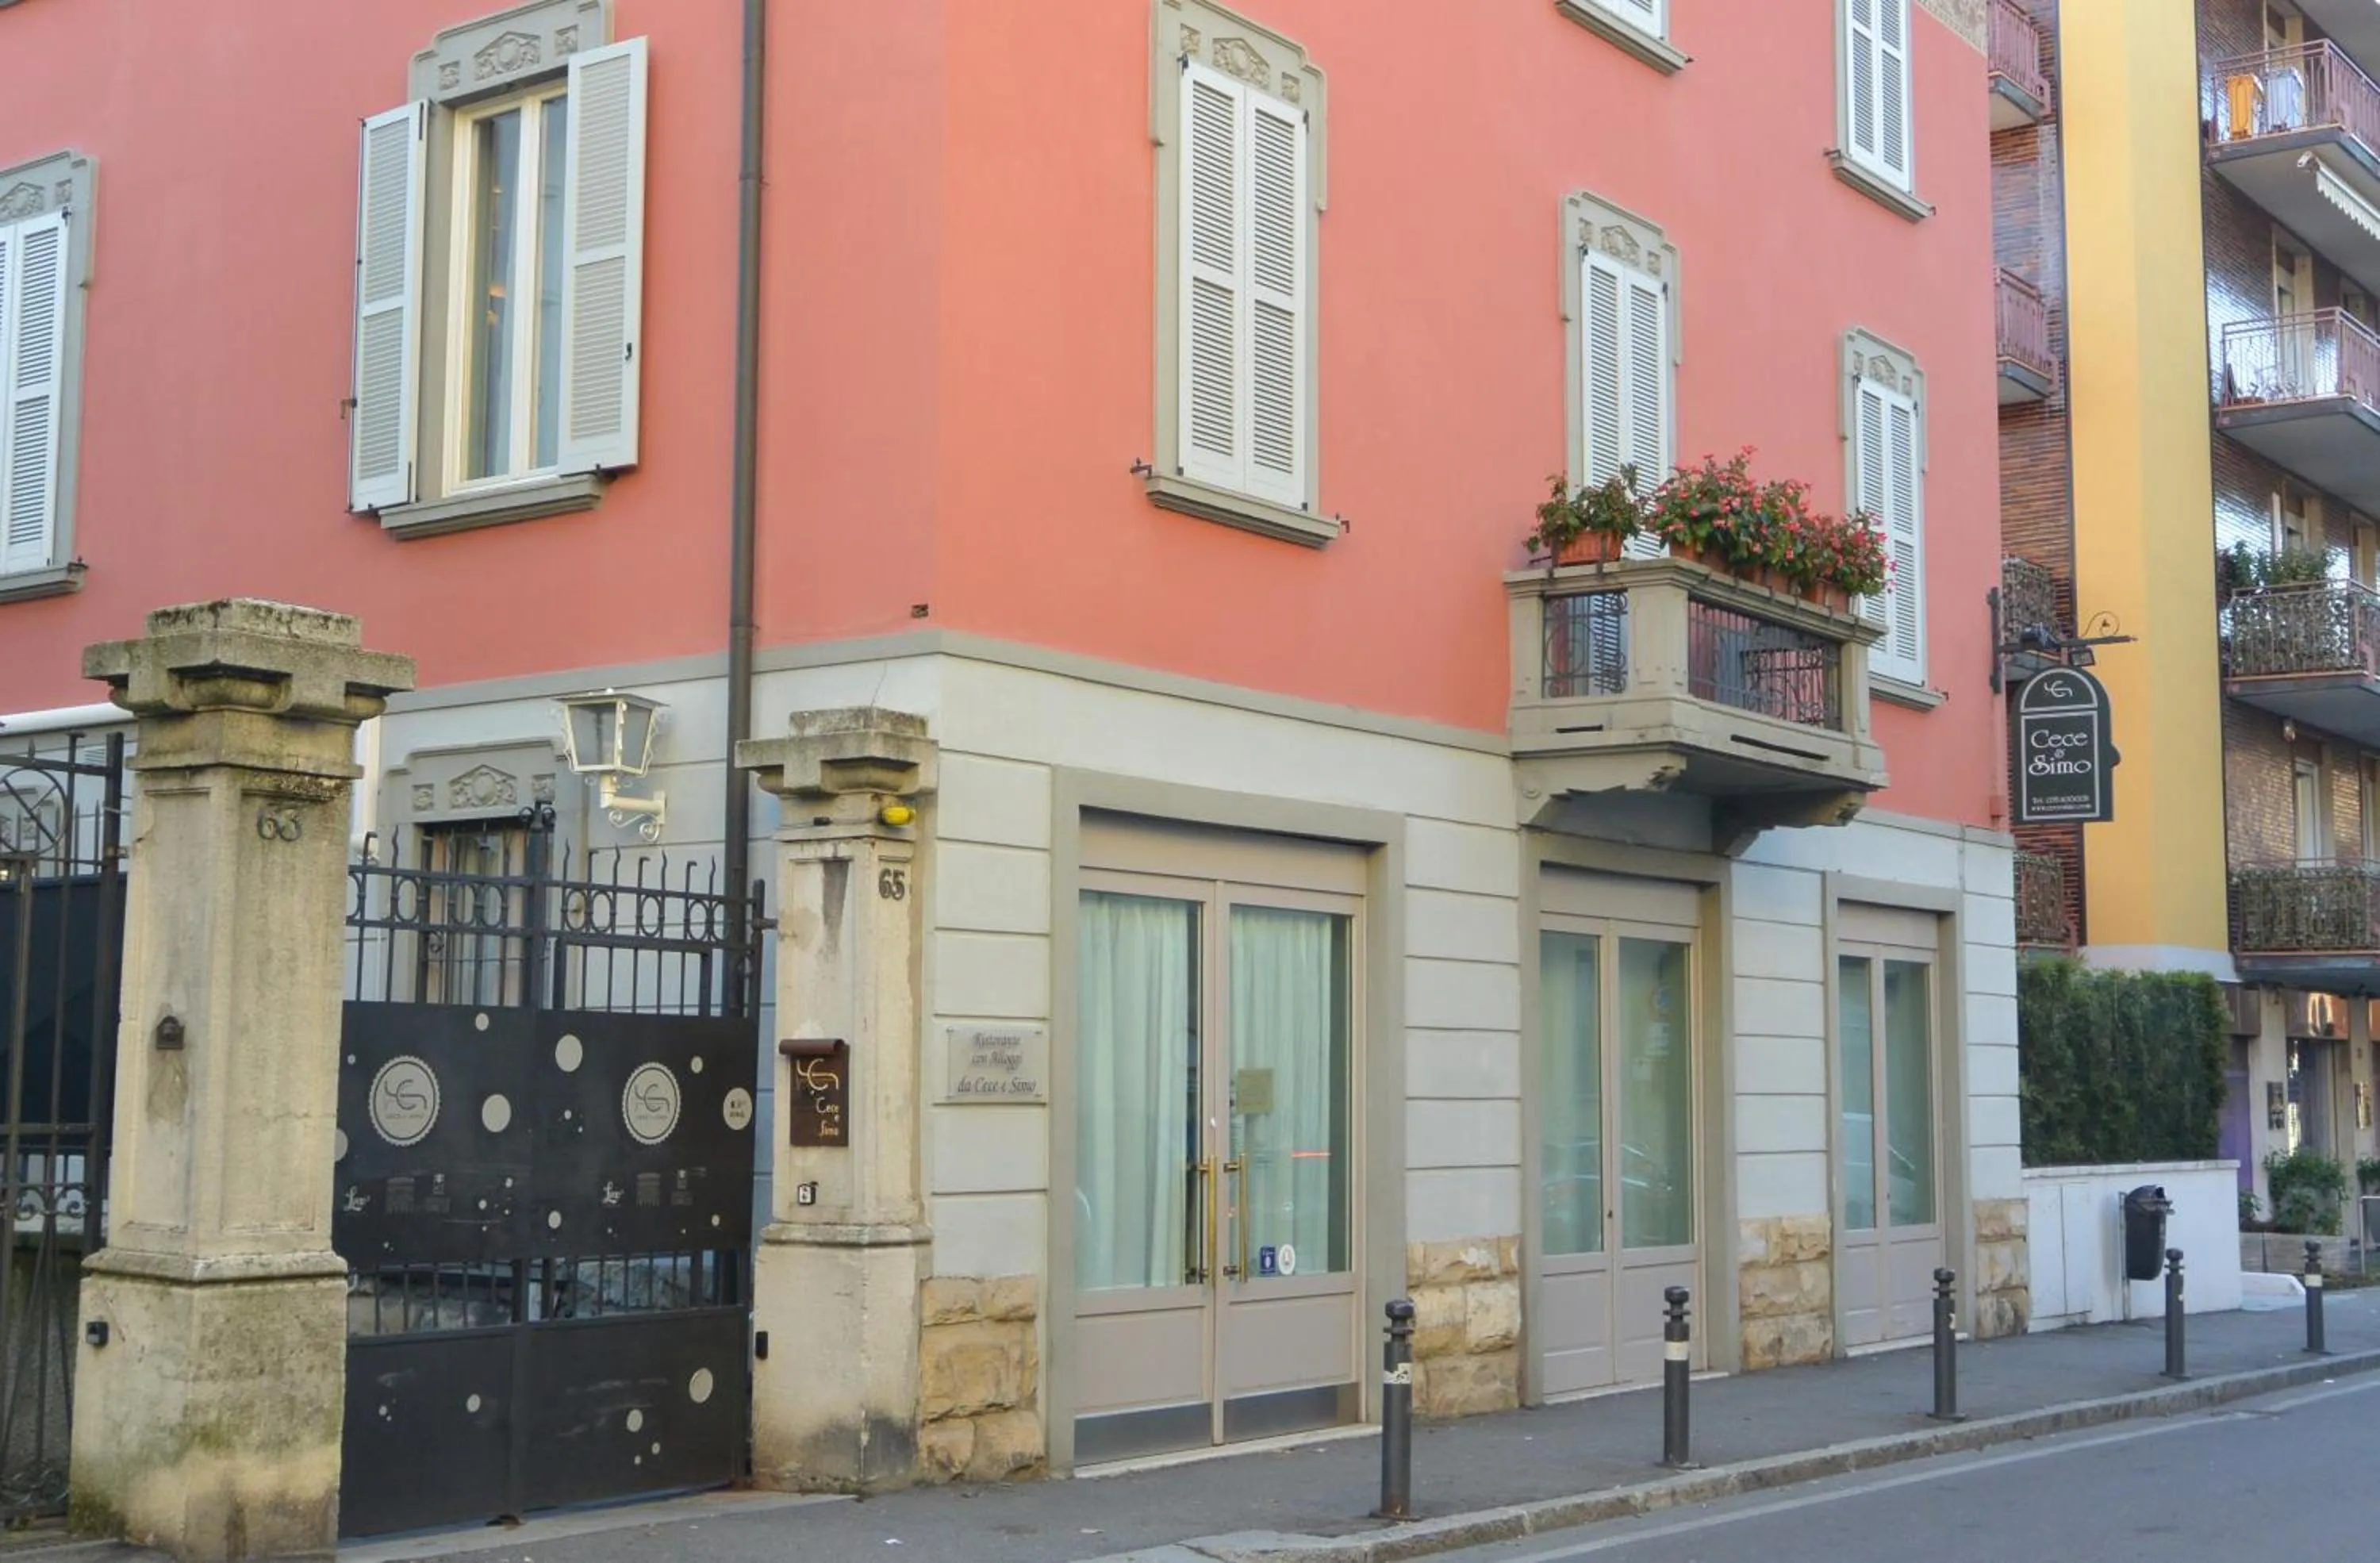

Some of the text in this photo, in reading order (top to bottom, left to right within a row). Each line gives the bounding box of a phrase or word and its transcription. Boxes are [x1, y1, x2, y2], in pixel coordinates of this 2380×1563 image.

[2030, 729, 2088, 747] Cece
[2029, 754, 2092, 776] Simo
[878, 867, 905, 901] 65
[958, 1075, 971, 1093] da
[974, 1077, 999, 1093] Cece
[1008, 1077, 1037, 1094] Simo
[816, 1096, 839, 1113] Cece
